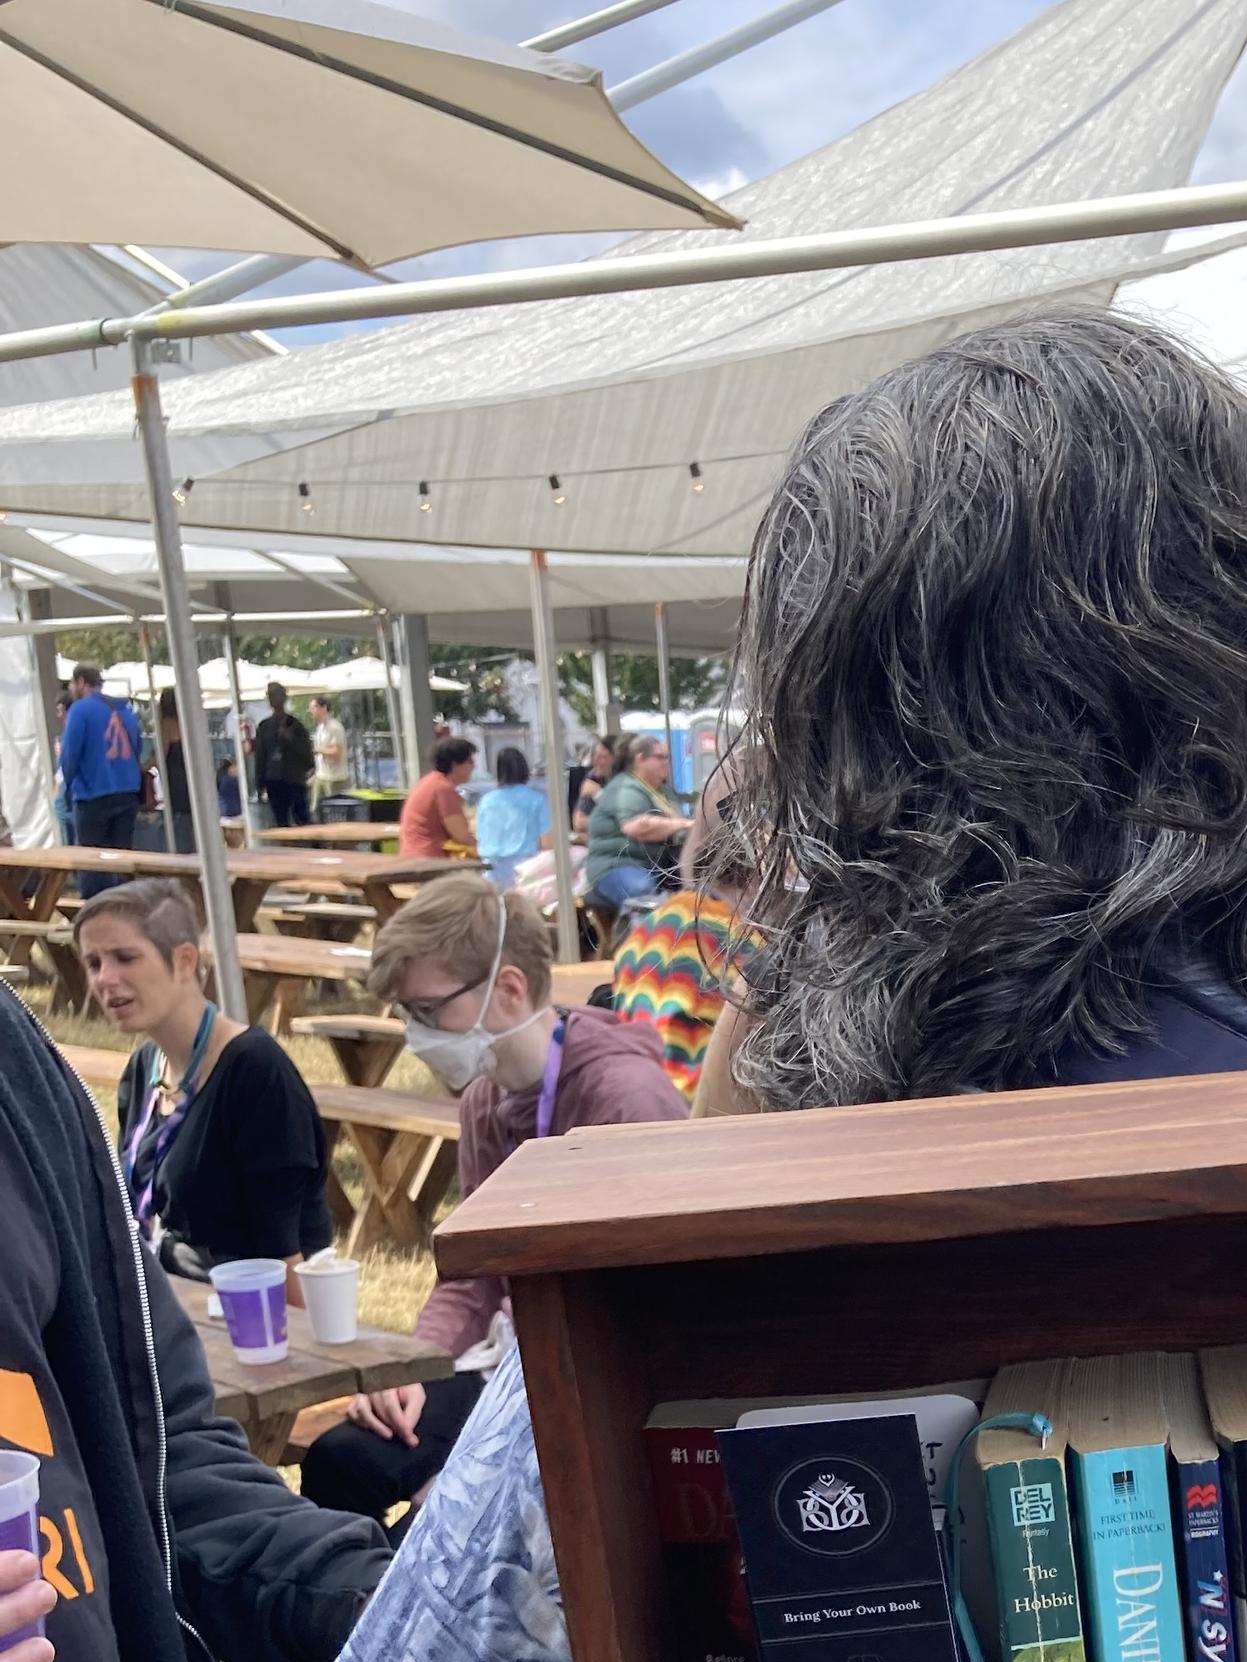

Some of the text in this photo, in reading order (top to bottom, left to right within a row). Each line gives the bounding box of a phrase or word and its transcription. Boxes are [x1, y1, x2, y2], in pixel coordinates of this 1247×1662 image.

[670, 1448, 688, 1463] #1
[1013, 1487, 1051, 1506] DEL
[1016, 1503, 1053, 1523] REY
[1100, 1509, 1156, 1525] FIRST TIME
[1093, 1529, 1105, 1540] IN
[1023, 1565, 1058, 1582] The
[784, 1600, 921, 1623] Bring Your Own Book
[1013, 1592, 1074, 1614] Hobbit
